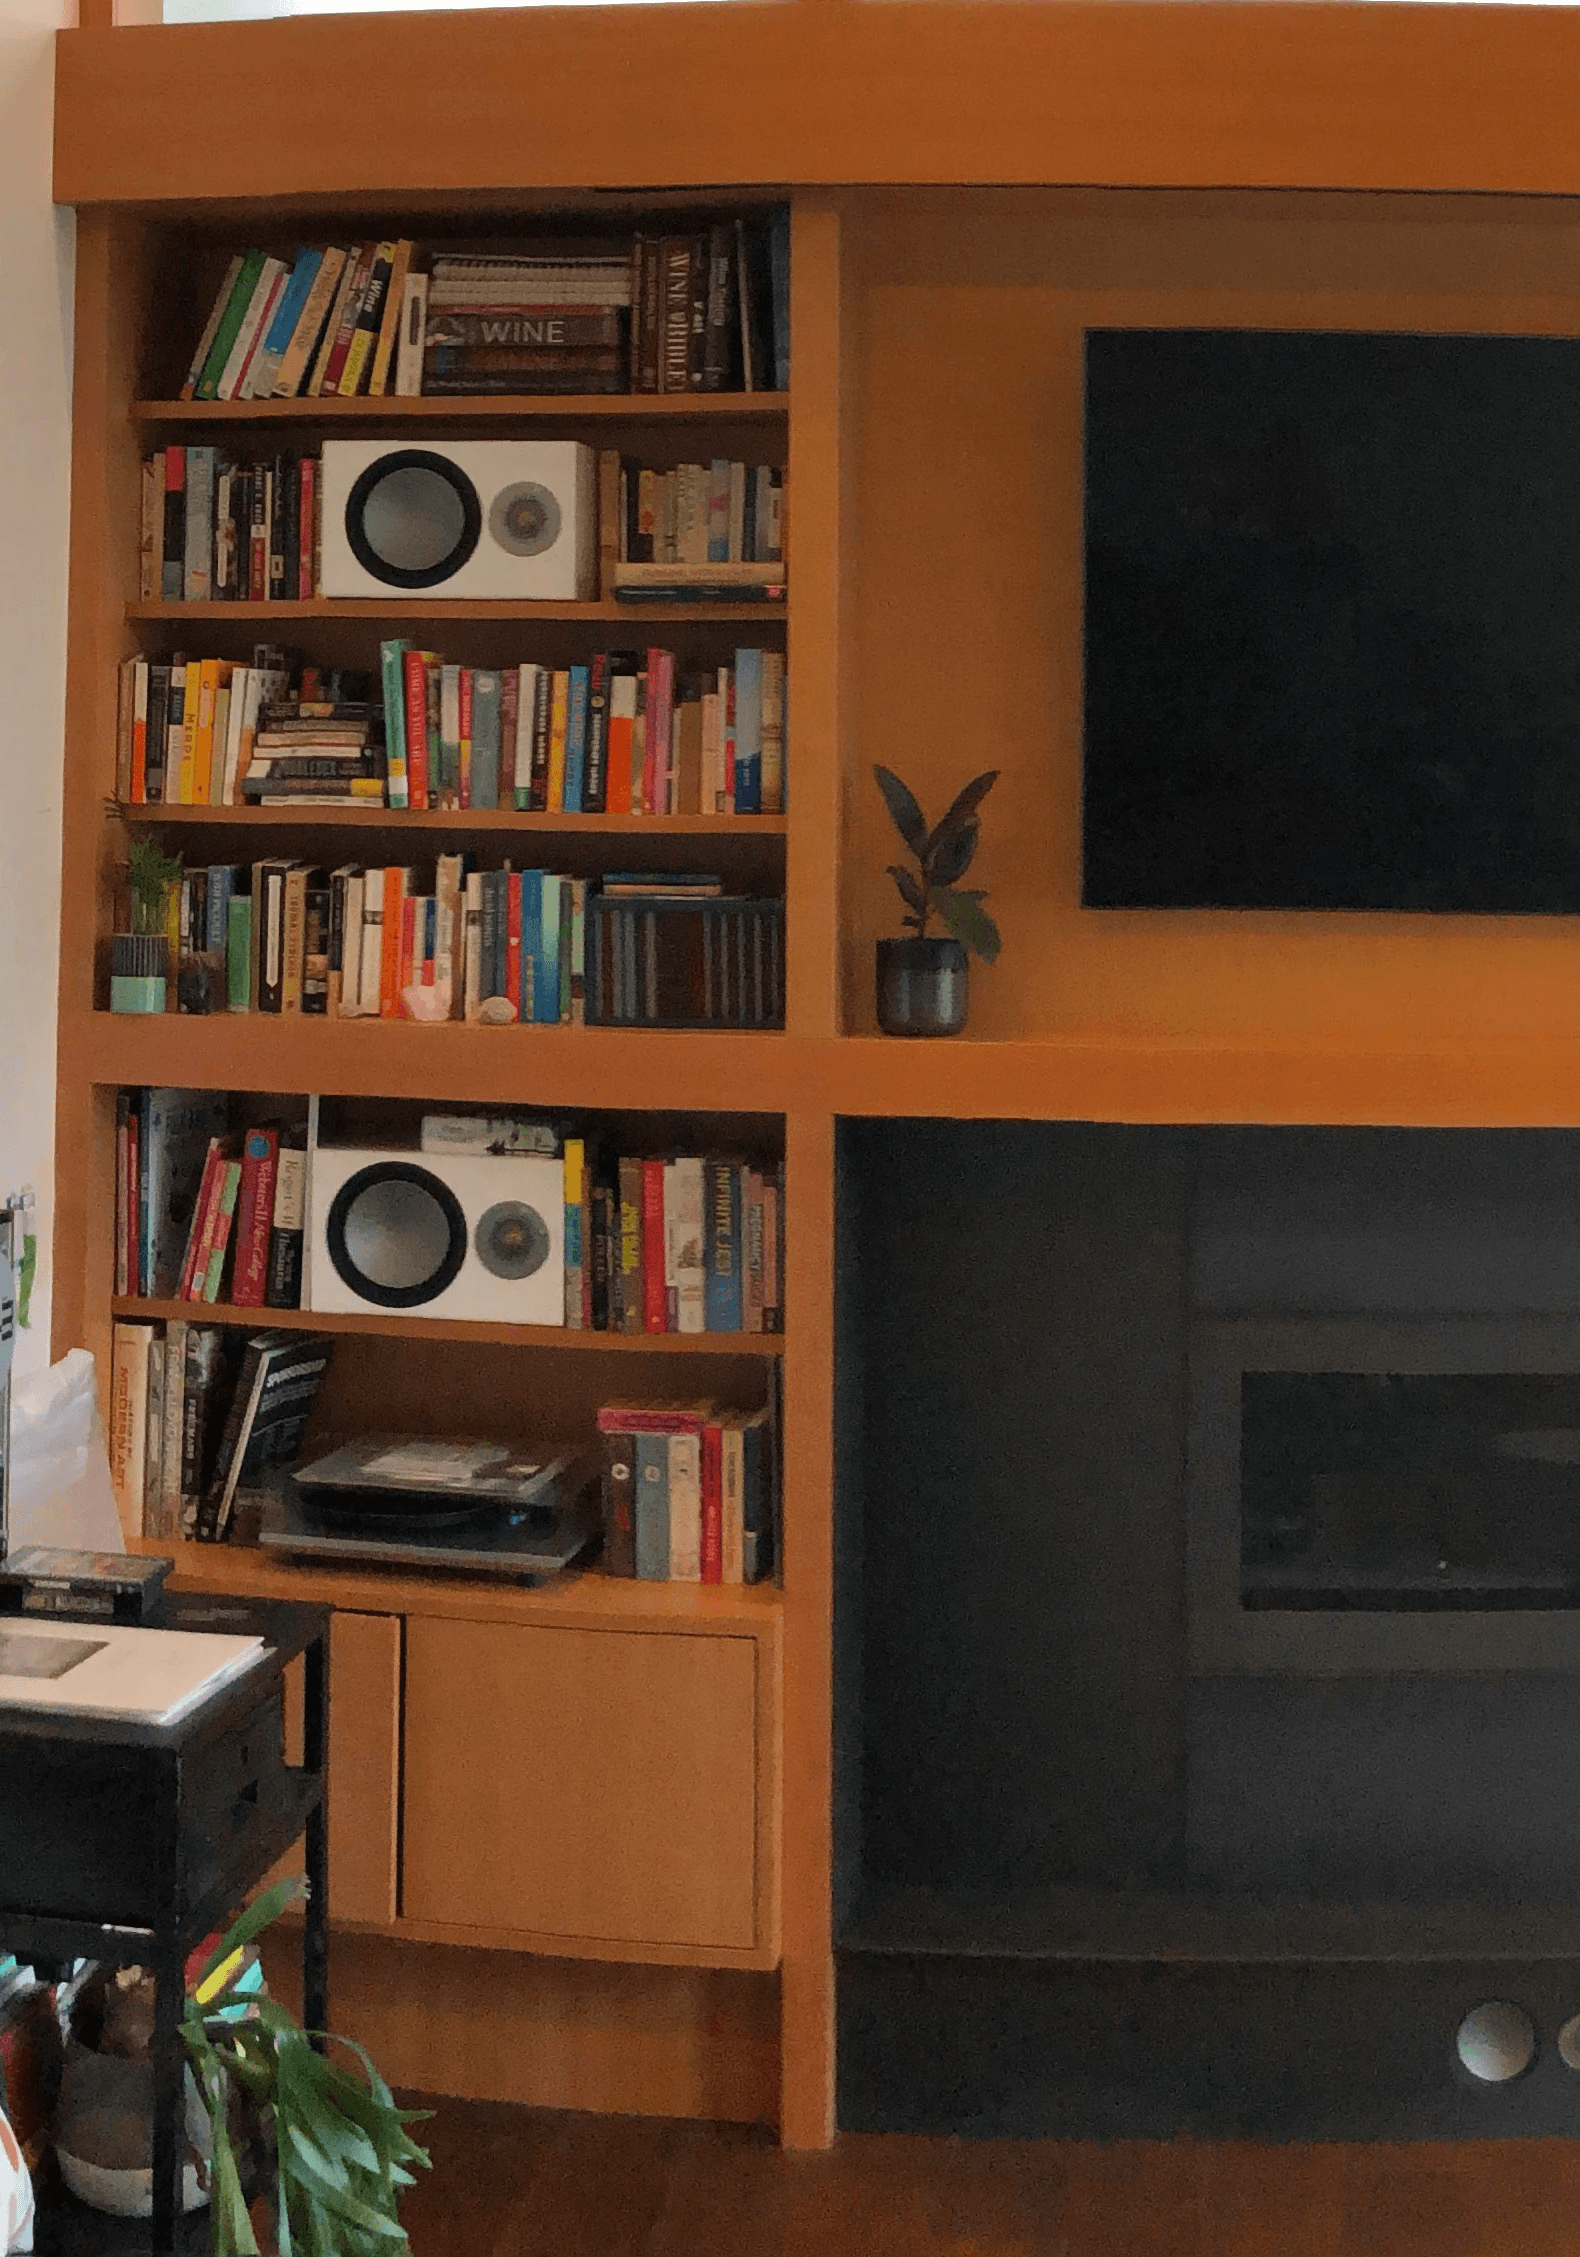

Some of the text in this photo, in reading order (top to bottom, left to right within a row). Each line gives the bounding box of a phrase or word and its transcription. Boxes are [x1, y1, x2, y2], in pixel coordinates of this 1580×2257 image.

[362, 280, 384, 313] Wine
[667, 252, 690, 306] WINE
[481, 321, 566, 344] WINE
[716, 1167, 733, 1235] INFINITE
[715, 1237, 732, 1277] JEST
[115, 1366, 129, 1490] MODERN ART
